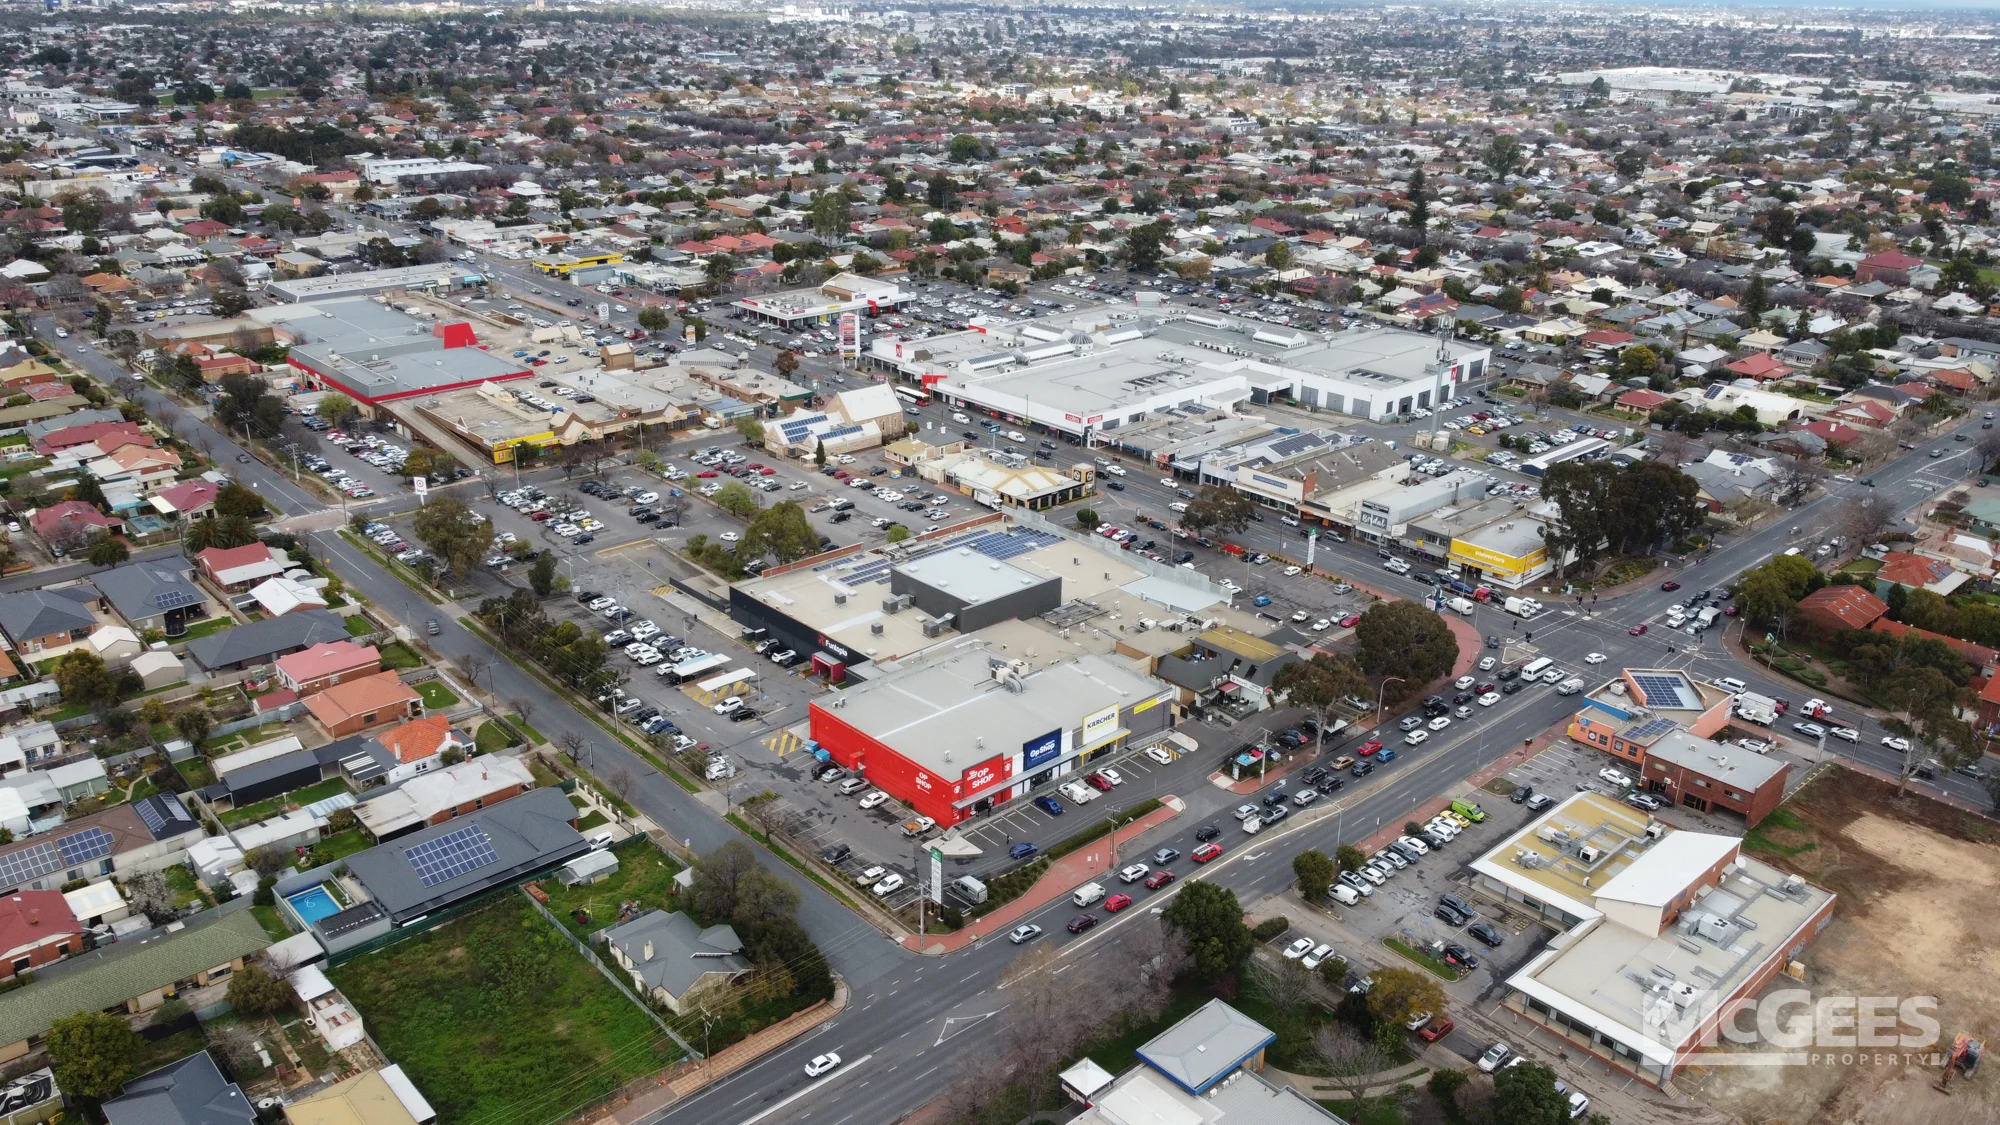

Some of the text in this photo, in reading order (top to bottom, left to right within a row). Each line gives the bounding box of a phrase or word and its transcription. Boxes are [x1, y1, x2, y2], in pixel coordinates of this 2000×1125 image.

[1362, 514, 1386, 527] Bridal
[825, 639, 848, 657] Funtopia
[918, 772, 928, 780] OP
[977, 767, 990, 778] OP
[915, 777, 932, 790] SHOP
[972, 773, 994, 789] SHOP
